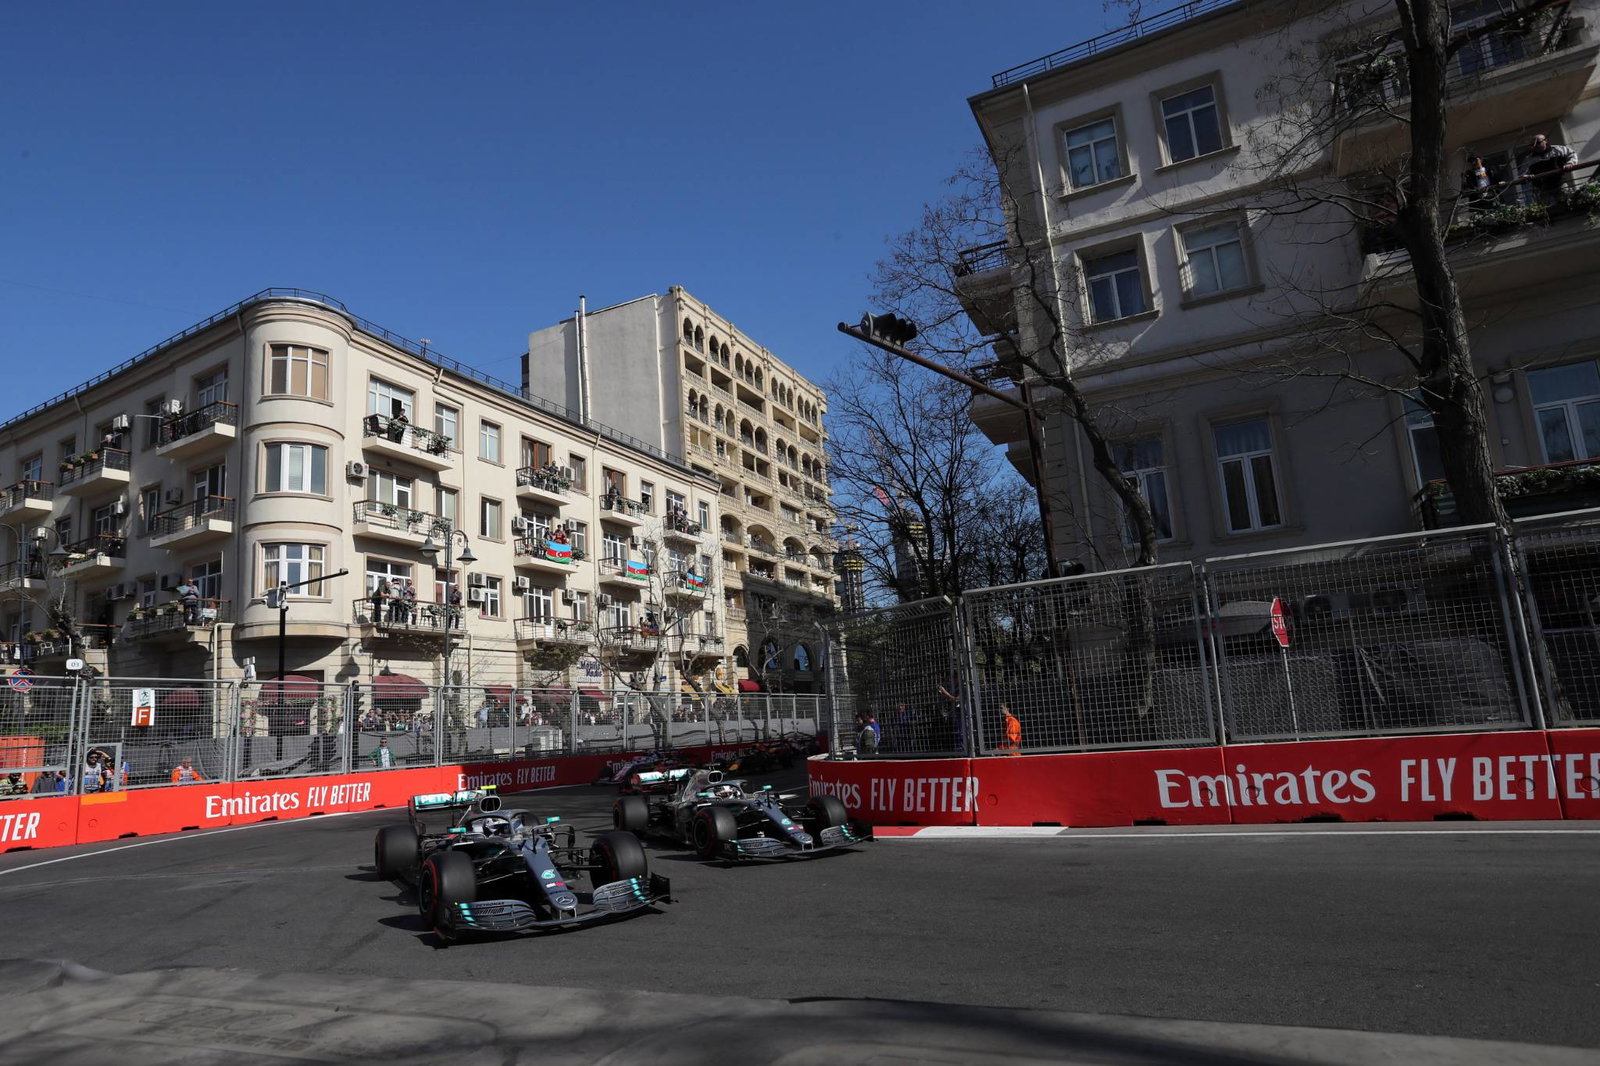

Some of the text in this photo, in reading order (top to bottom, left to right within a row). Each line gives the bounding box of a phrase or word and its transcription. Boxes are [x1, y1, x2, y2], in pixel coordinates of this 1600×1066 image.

[138, 709, 150, 724] F
[458, 765, 556, 791] Emirates FLY BETTER
[870, 778, 897, 812] FLY
[904, 776, 979, 812] BETTER
[1154, 764, 1376, 808] Emirates
[1400, 757, 1456, 801] FLY
[205, 782, 371, 819] Emirates FLY BETTER
[0, 812, 41, 843] TER
